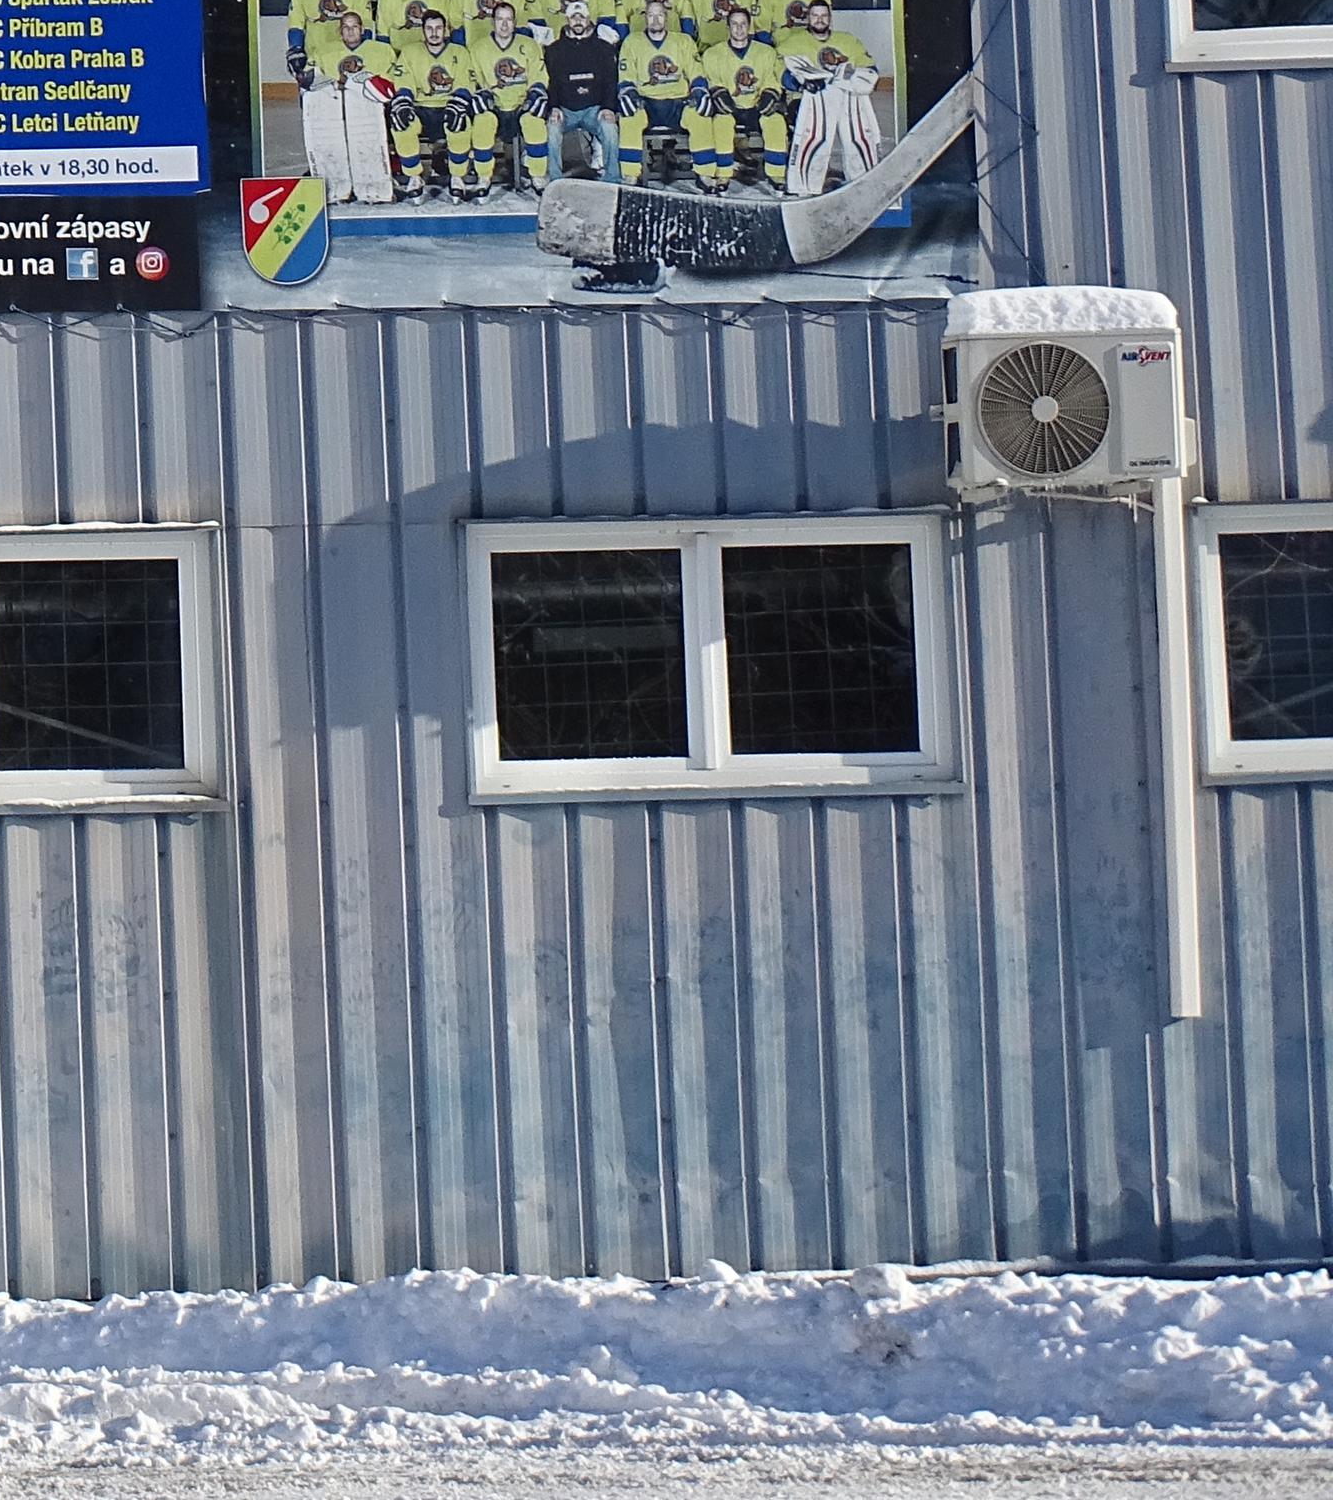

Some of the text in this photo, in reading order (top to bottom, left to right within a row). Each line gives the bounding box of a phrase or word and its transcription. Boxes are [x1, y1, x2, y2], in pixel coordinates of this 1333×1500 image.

[9, 17, 85, 38] Příbram
[90, 17, 104, 37] B
[10, 49, 66, 70] Kobra
[71, 48, 126, 69] Praha
[131, 48, 145, 67] B
[44, 79, 131, 103] Sedlčany
[11, 112, 58, 133] Letci
[63, 111, 140, 134] Letňany
[39, 164, 51, 176] v
[57, 158, 110, 178] 18,30
[115, 157, 159, 175] hod.
[56, 213, 151, 244] zápasy
[22, 257, 55, 276] na
[109, 257, 126, 275] a
